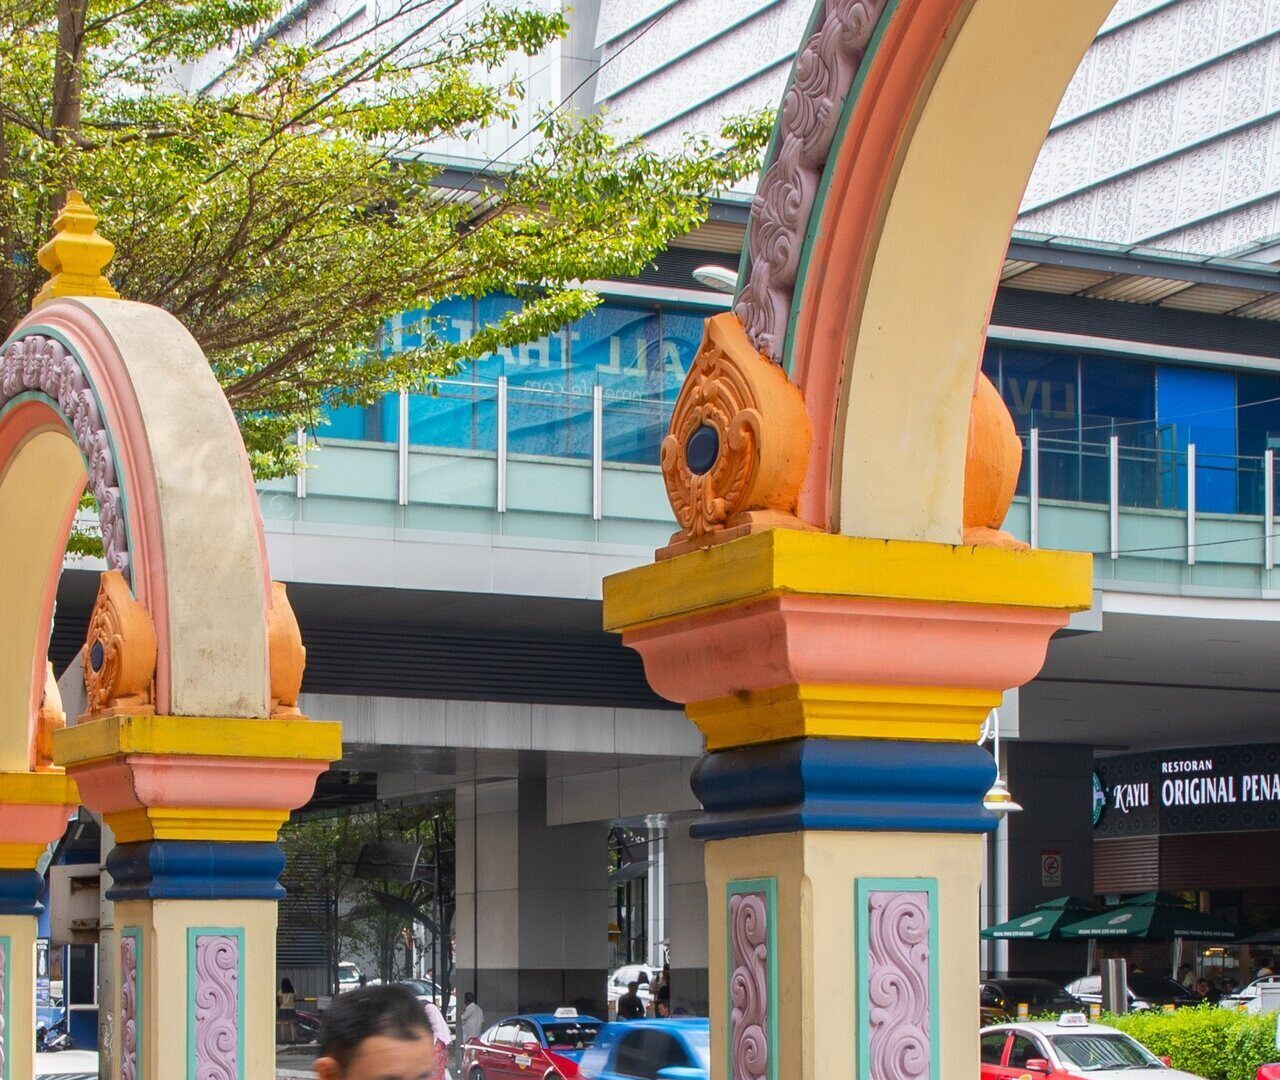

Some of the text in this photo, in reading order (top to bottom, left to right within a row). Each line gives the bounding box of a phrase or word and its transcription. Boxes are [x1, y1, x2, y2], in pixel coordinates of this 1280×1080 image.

[1162, 759, 1213, 774] RESTORAN
[1113, 782, 1150, 813] KAYU
[1161, 776, 1237, 806] ORIGINAL
